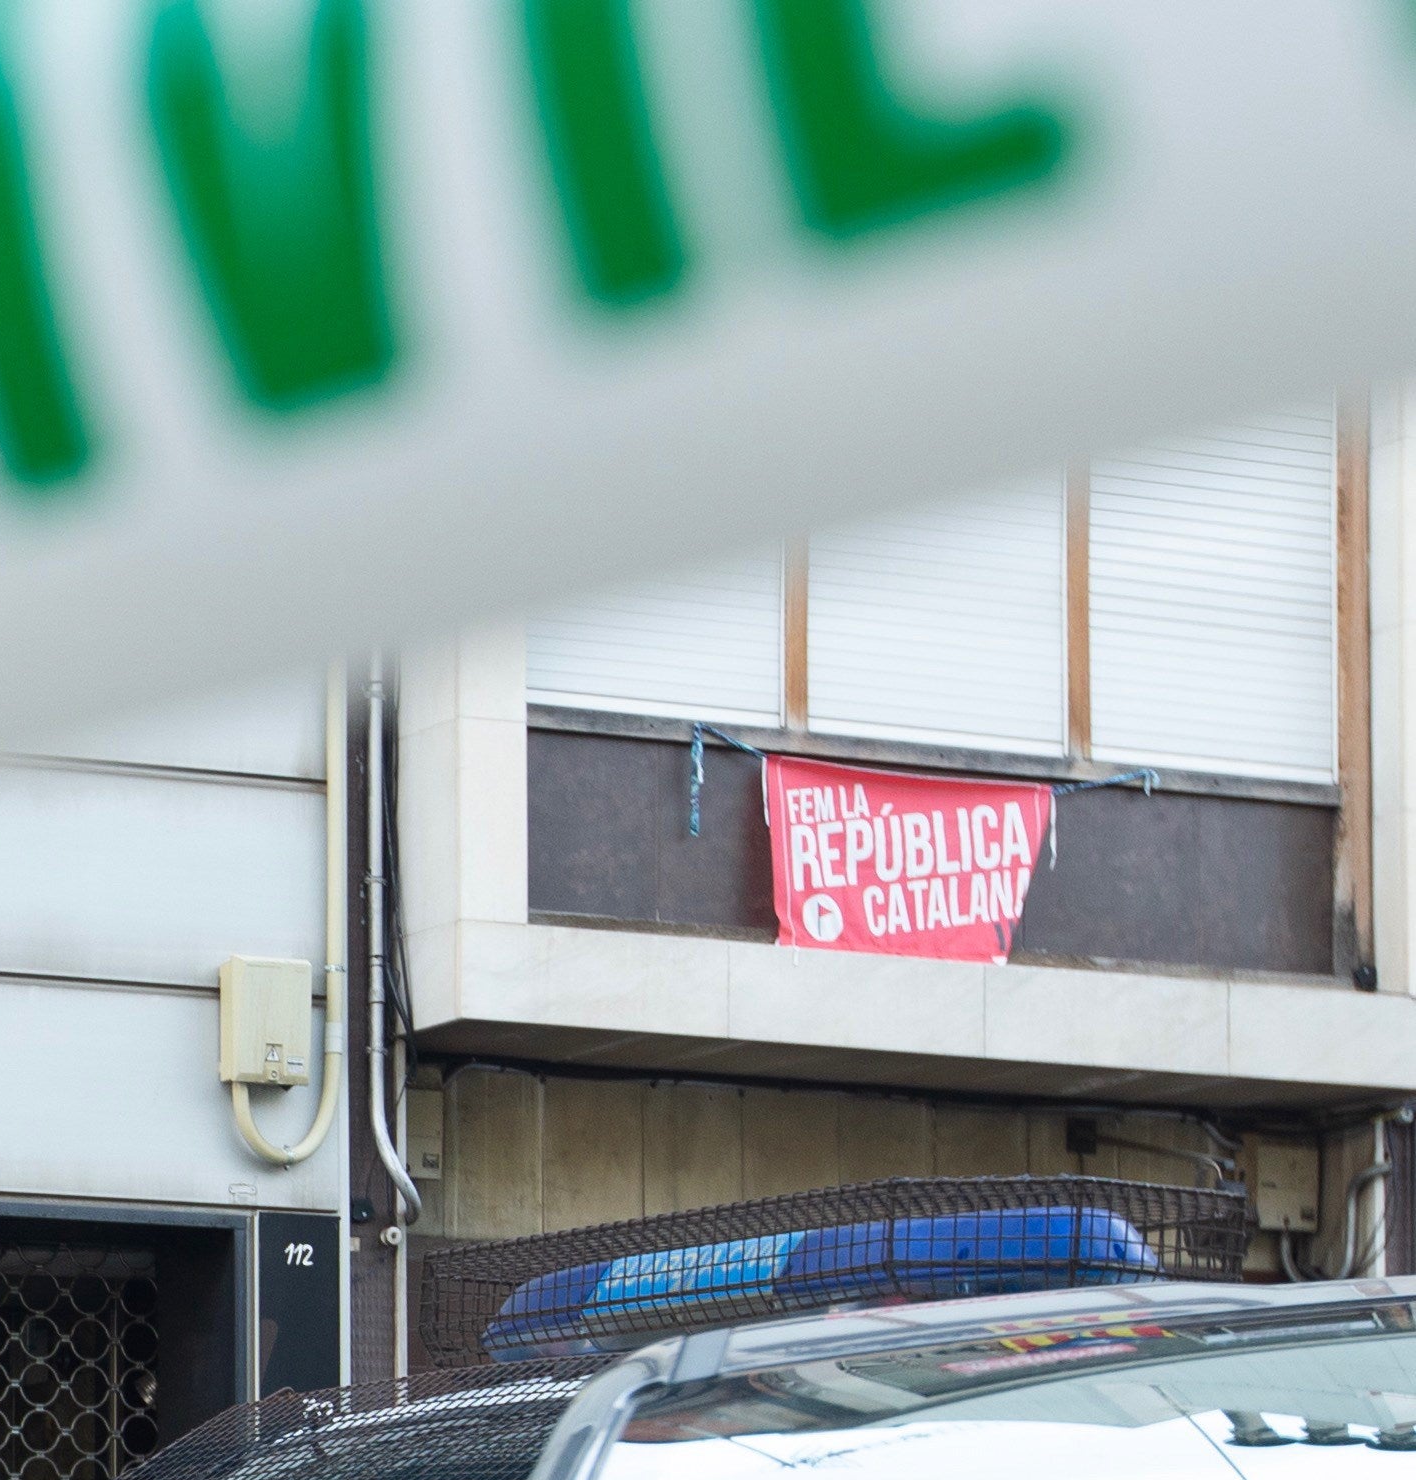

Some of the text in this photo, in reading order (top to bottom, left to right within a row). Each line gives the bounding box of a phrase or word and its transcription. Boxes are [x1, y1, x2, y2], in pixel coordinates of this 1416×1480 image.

[786, 783, 870, 825] FEM LA
[790, 801, 1032, 892] REPÚBLICA
[284, 1242, 314, 1266] 112
